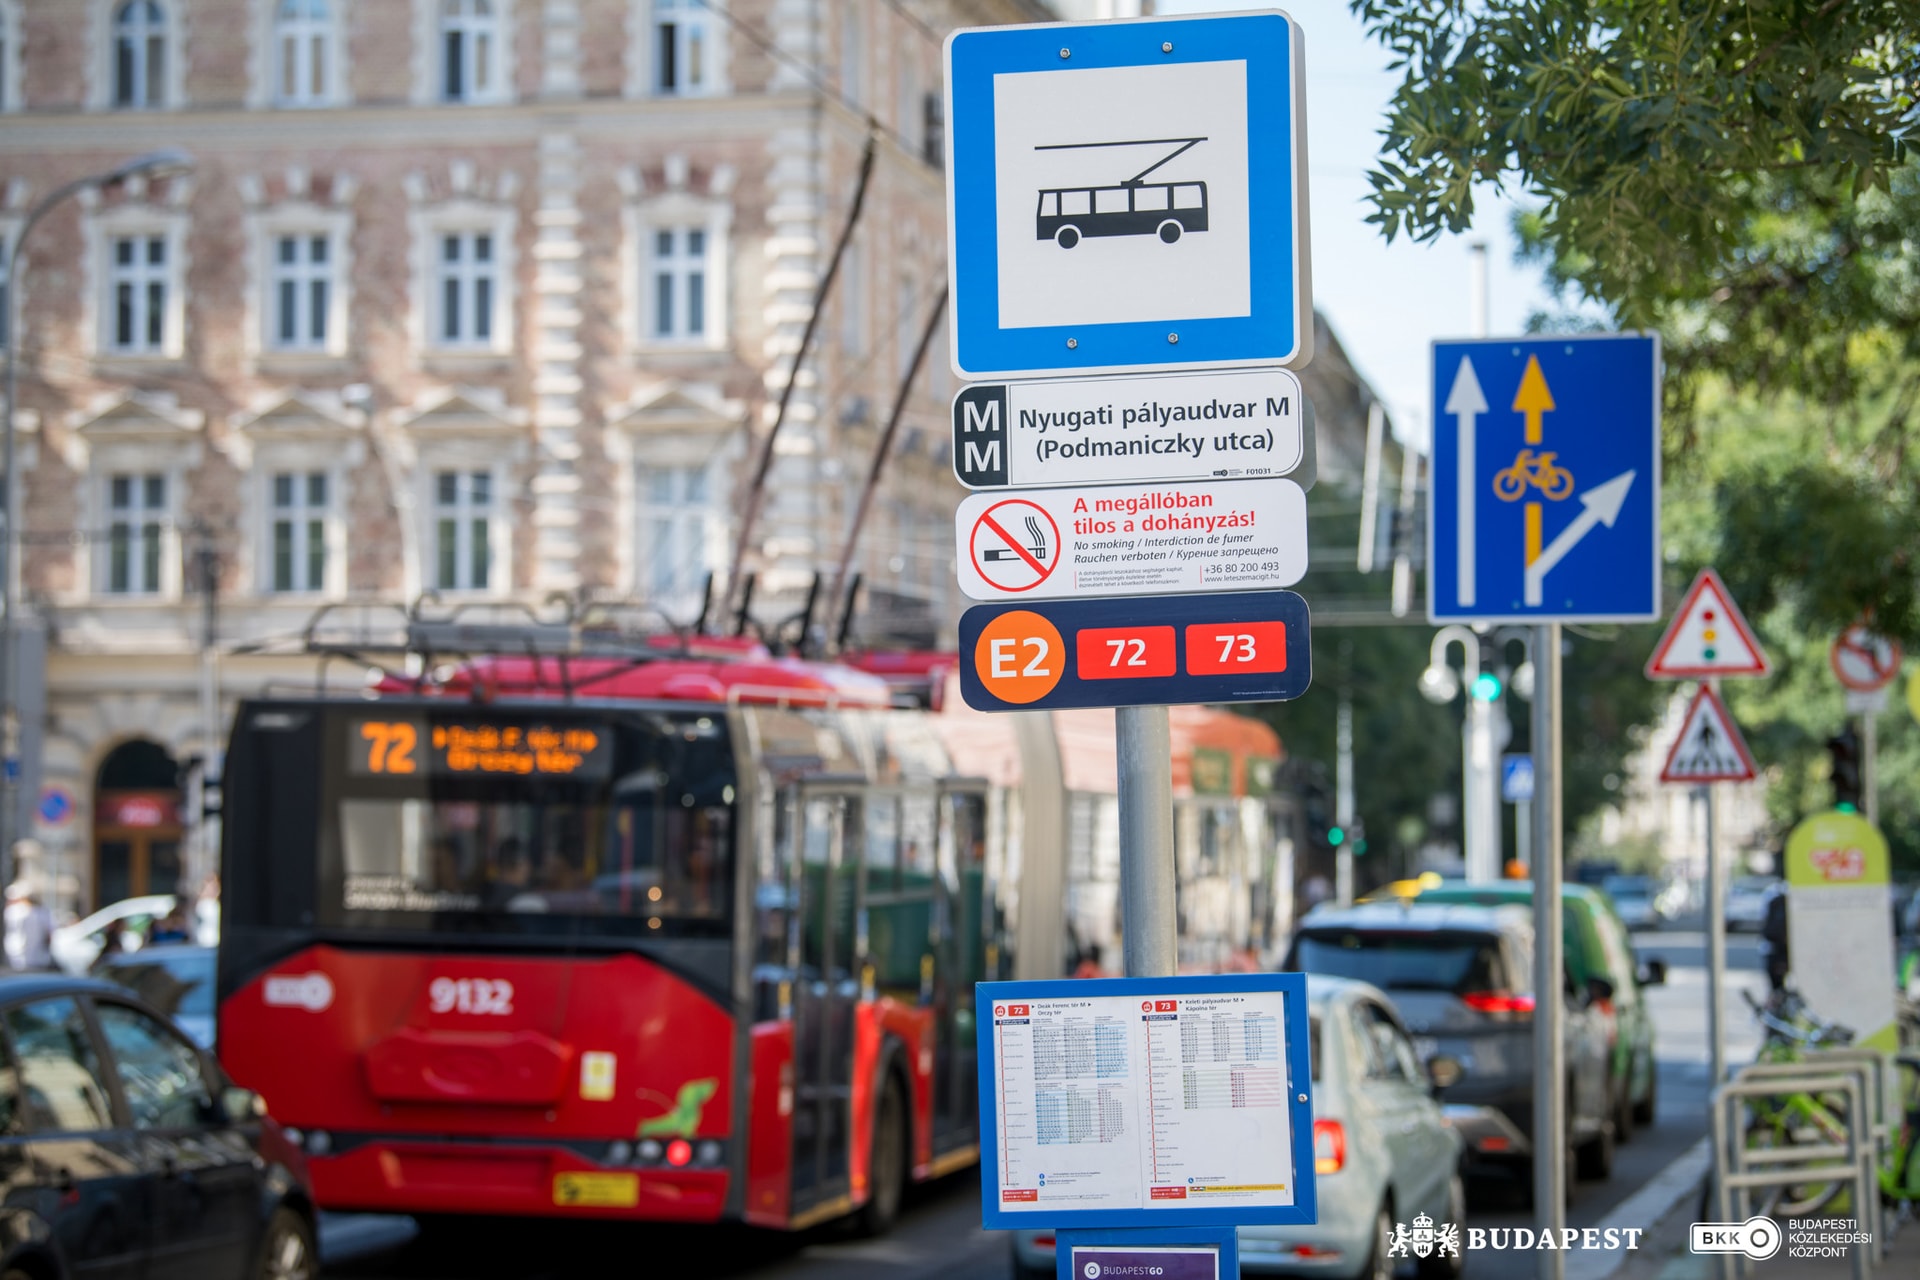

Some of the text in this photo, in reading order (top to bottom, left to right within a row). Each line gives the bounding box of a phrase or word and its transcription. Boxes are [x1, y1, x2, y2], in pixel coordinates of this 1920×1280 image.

[964, 400, 1000, 432] M
[1020, 397, 1289, 433] Nyugati pályaudvar M
[965, 440, 1000, 472] M
[1036, 428, 1274, 462] (Podmaniczky utca)
[1073, 492, 1212, 515] A megállóban
[1073, 510, 1255, 534] tilos a dohányzás!
[1074, 542, 1088, 550] No
[1092, 539, 1134, 550] smoking
[1145, 536, 1203, 546] Interdiction
[1207, 535, 1220, 544] de
[1222, 534, 1254, 545] fumer
[1074, 553, 1118, 563] Rauchen
[1121, 551, 1166, 561] verboten
[1176, 549, 1219, 560] Курение
[1220, 547, 1279, 558] запрещено
[1204, 562, 1279, 574] +36 80 200 493
[1204, 573, 1280, 582] www.leteszemacigit.hu
[990, 634, 1257, 678] E2 72 73
[361, 721, 417, 773] 72
[429, 976, 514, 1015] 9132
[1103, 1266, 1163, 1275] BUDAPESTGO
